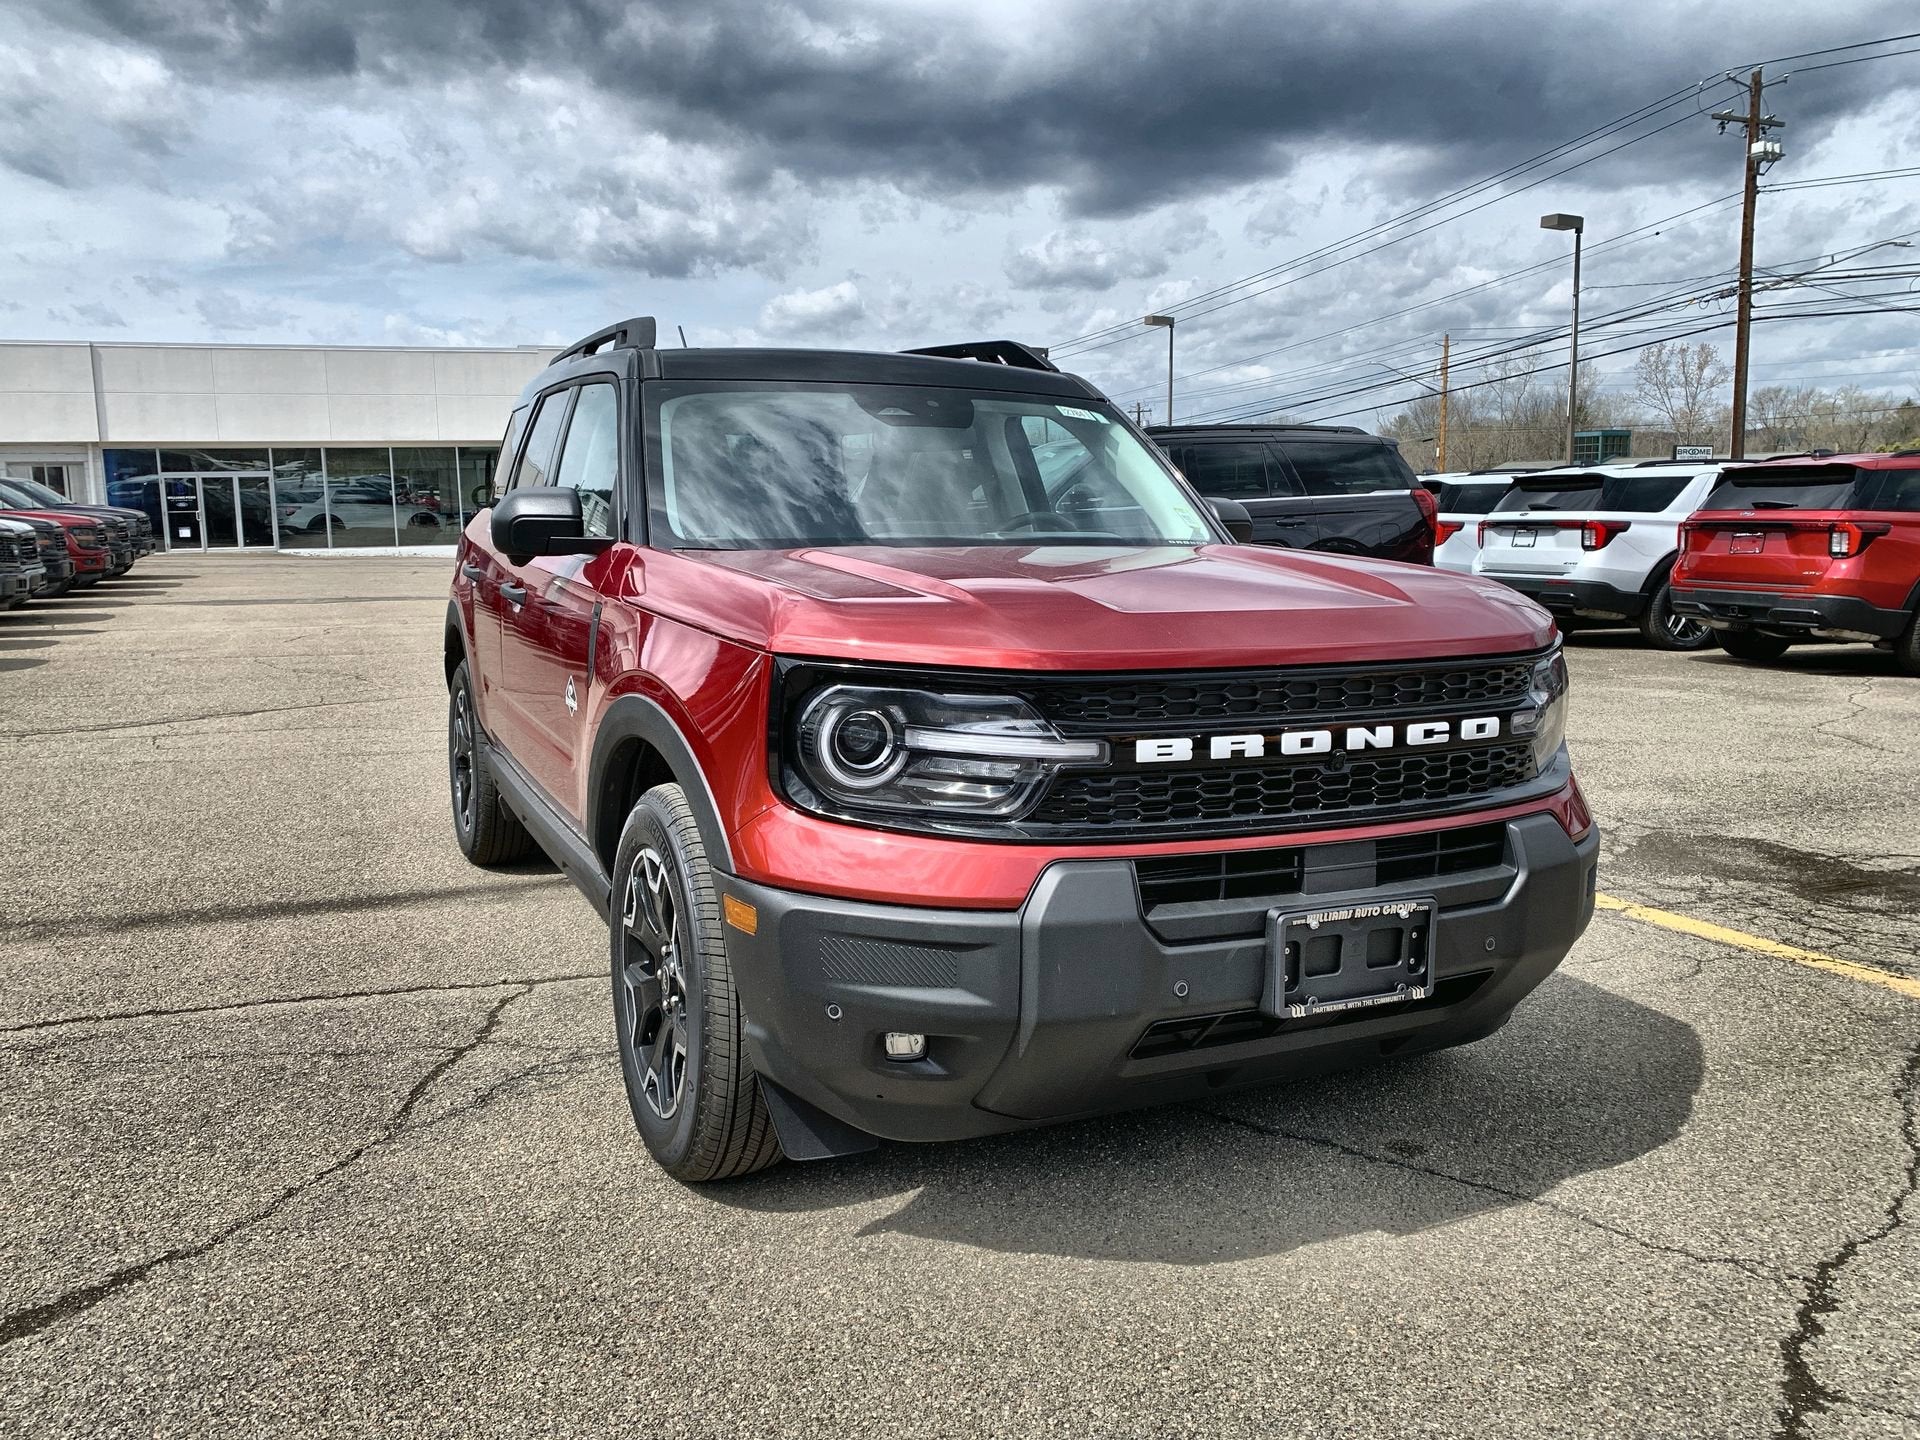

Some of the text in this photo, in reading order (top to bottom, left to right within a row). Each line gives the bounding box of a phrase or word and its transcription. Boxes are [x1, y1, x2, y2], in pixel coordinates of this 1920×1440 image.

[1677, 448, 1712, 456] BROOME
[1136, 716, 1500, 763] BRONCO
[1354, 906, 1380, 919] AUTO
[1347, 1001, 1362, 1010] WITH
[1362, 999, 1374, 1008] THE
